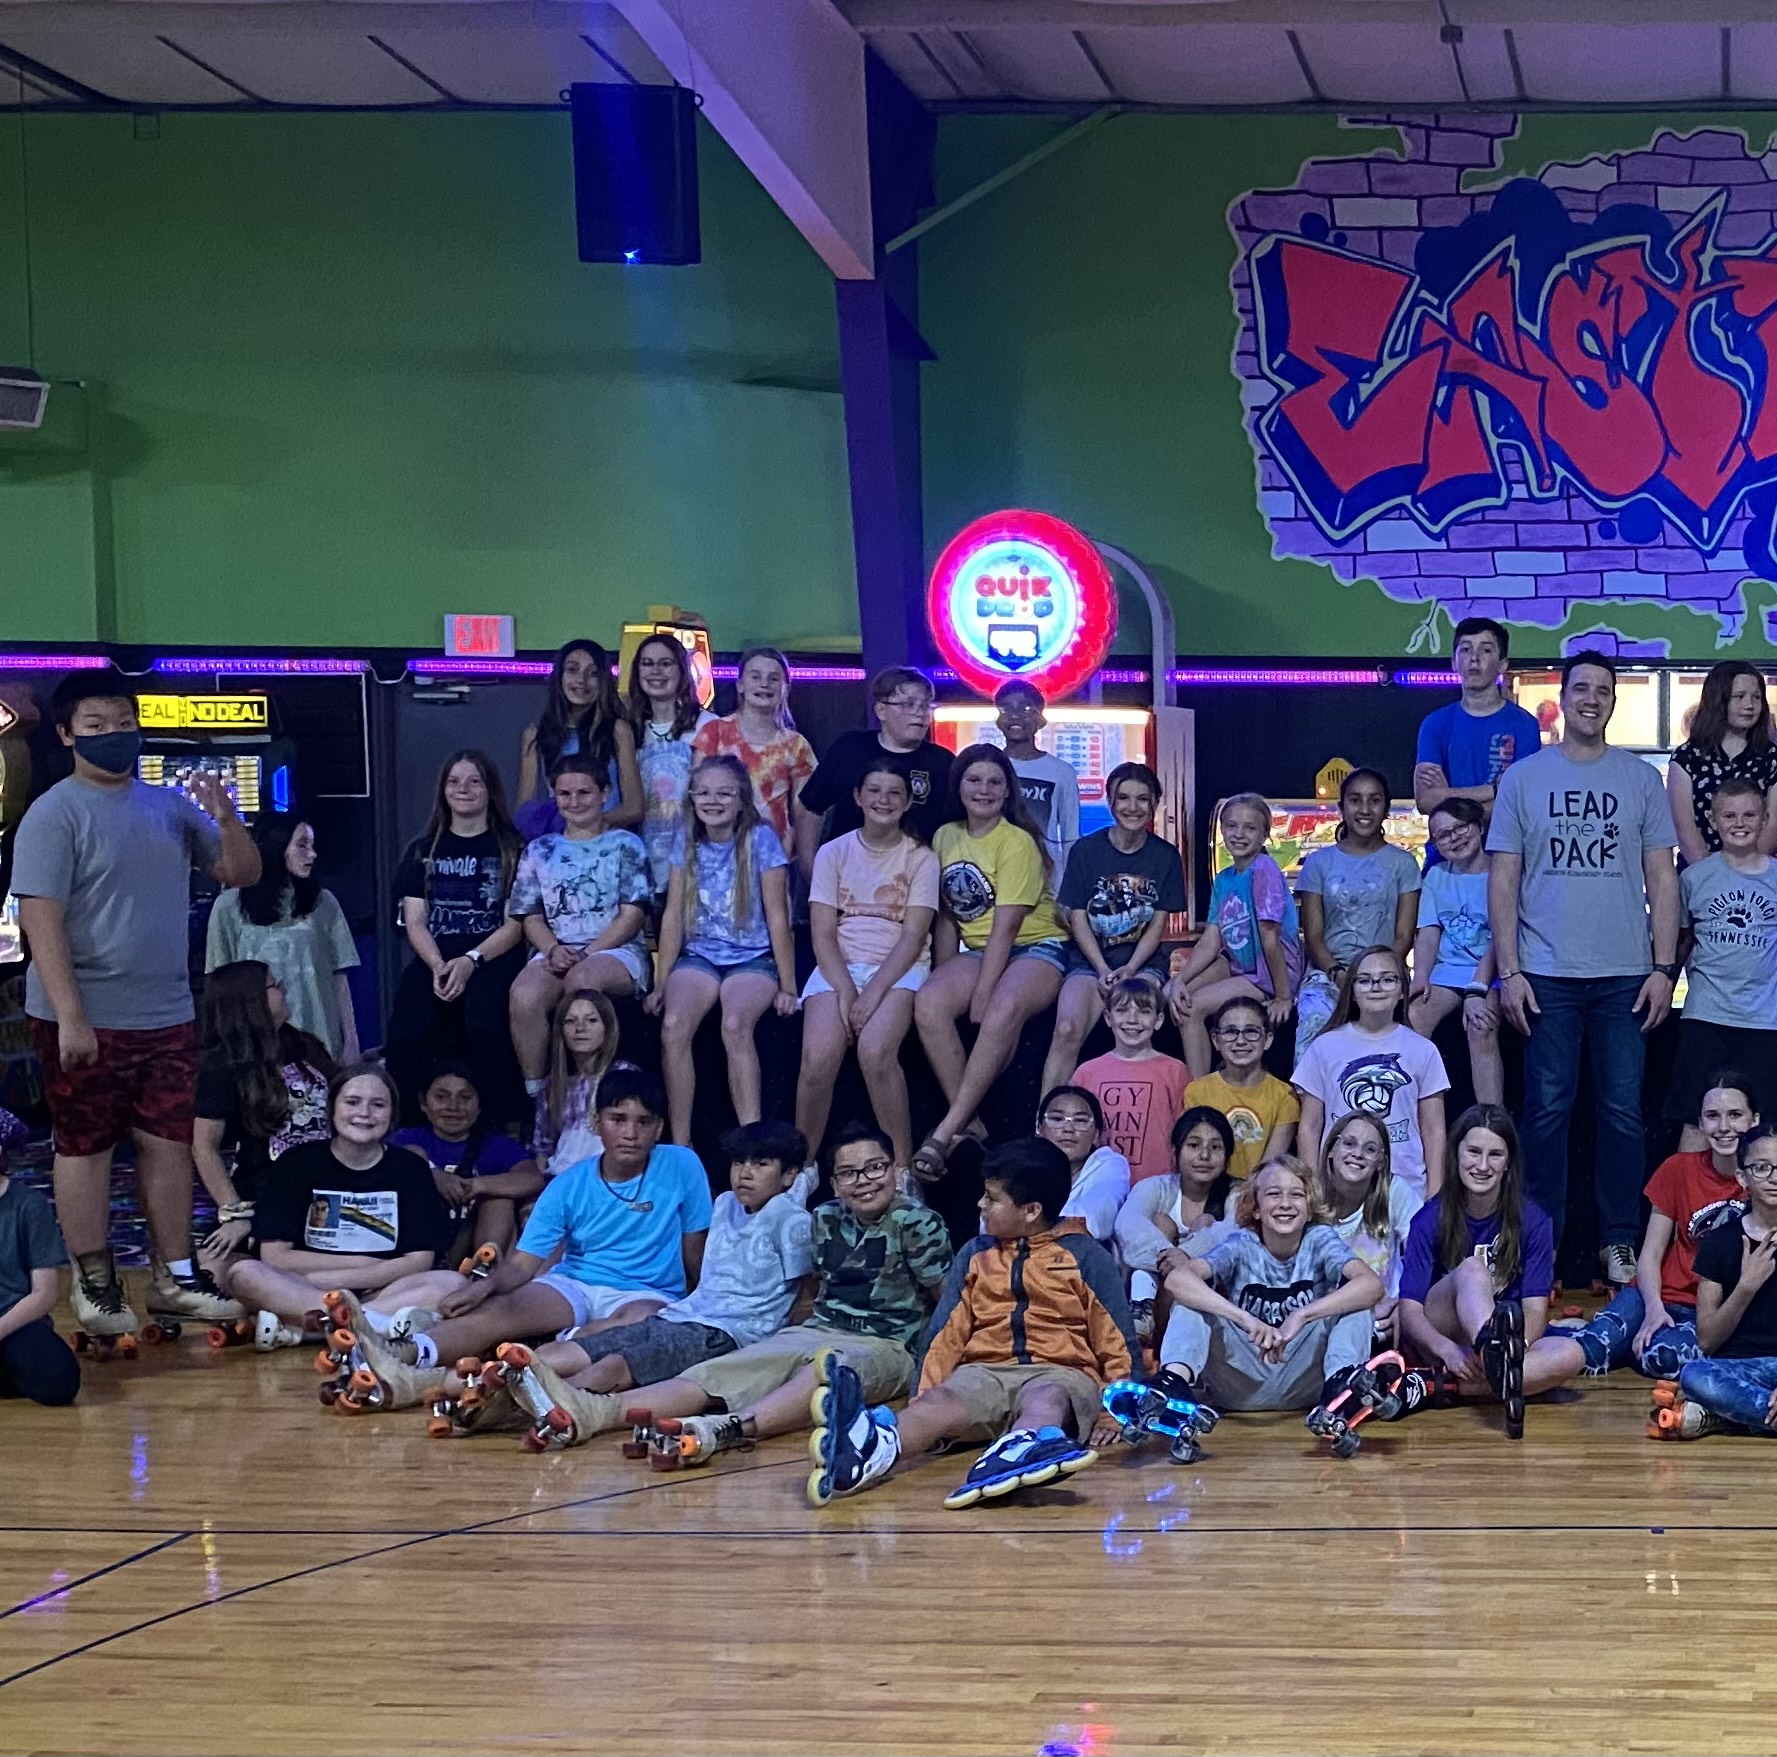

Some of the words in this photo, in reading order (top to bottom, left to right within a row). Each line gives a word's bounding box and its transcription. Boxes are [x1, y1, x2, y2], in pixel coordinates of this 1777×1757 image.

[975, 565, 1053, 601] QUIK
[141, 703, 176, 719] EAL
[1549, 790, 1619, 821] LEAD
[1554, 819, 1595, 837] the
[1549, 836, 1619, 869] PACK
